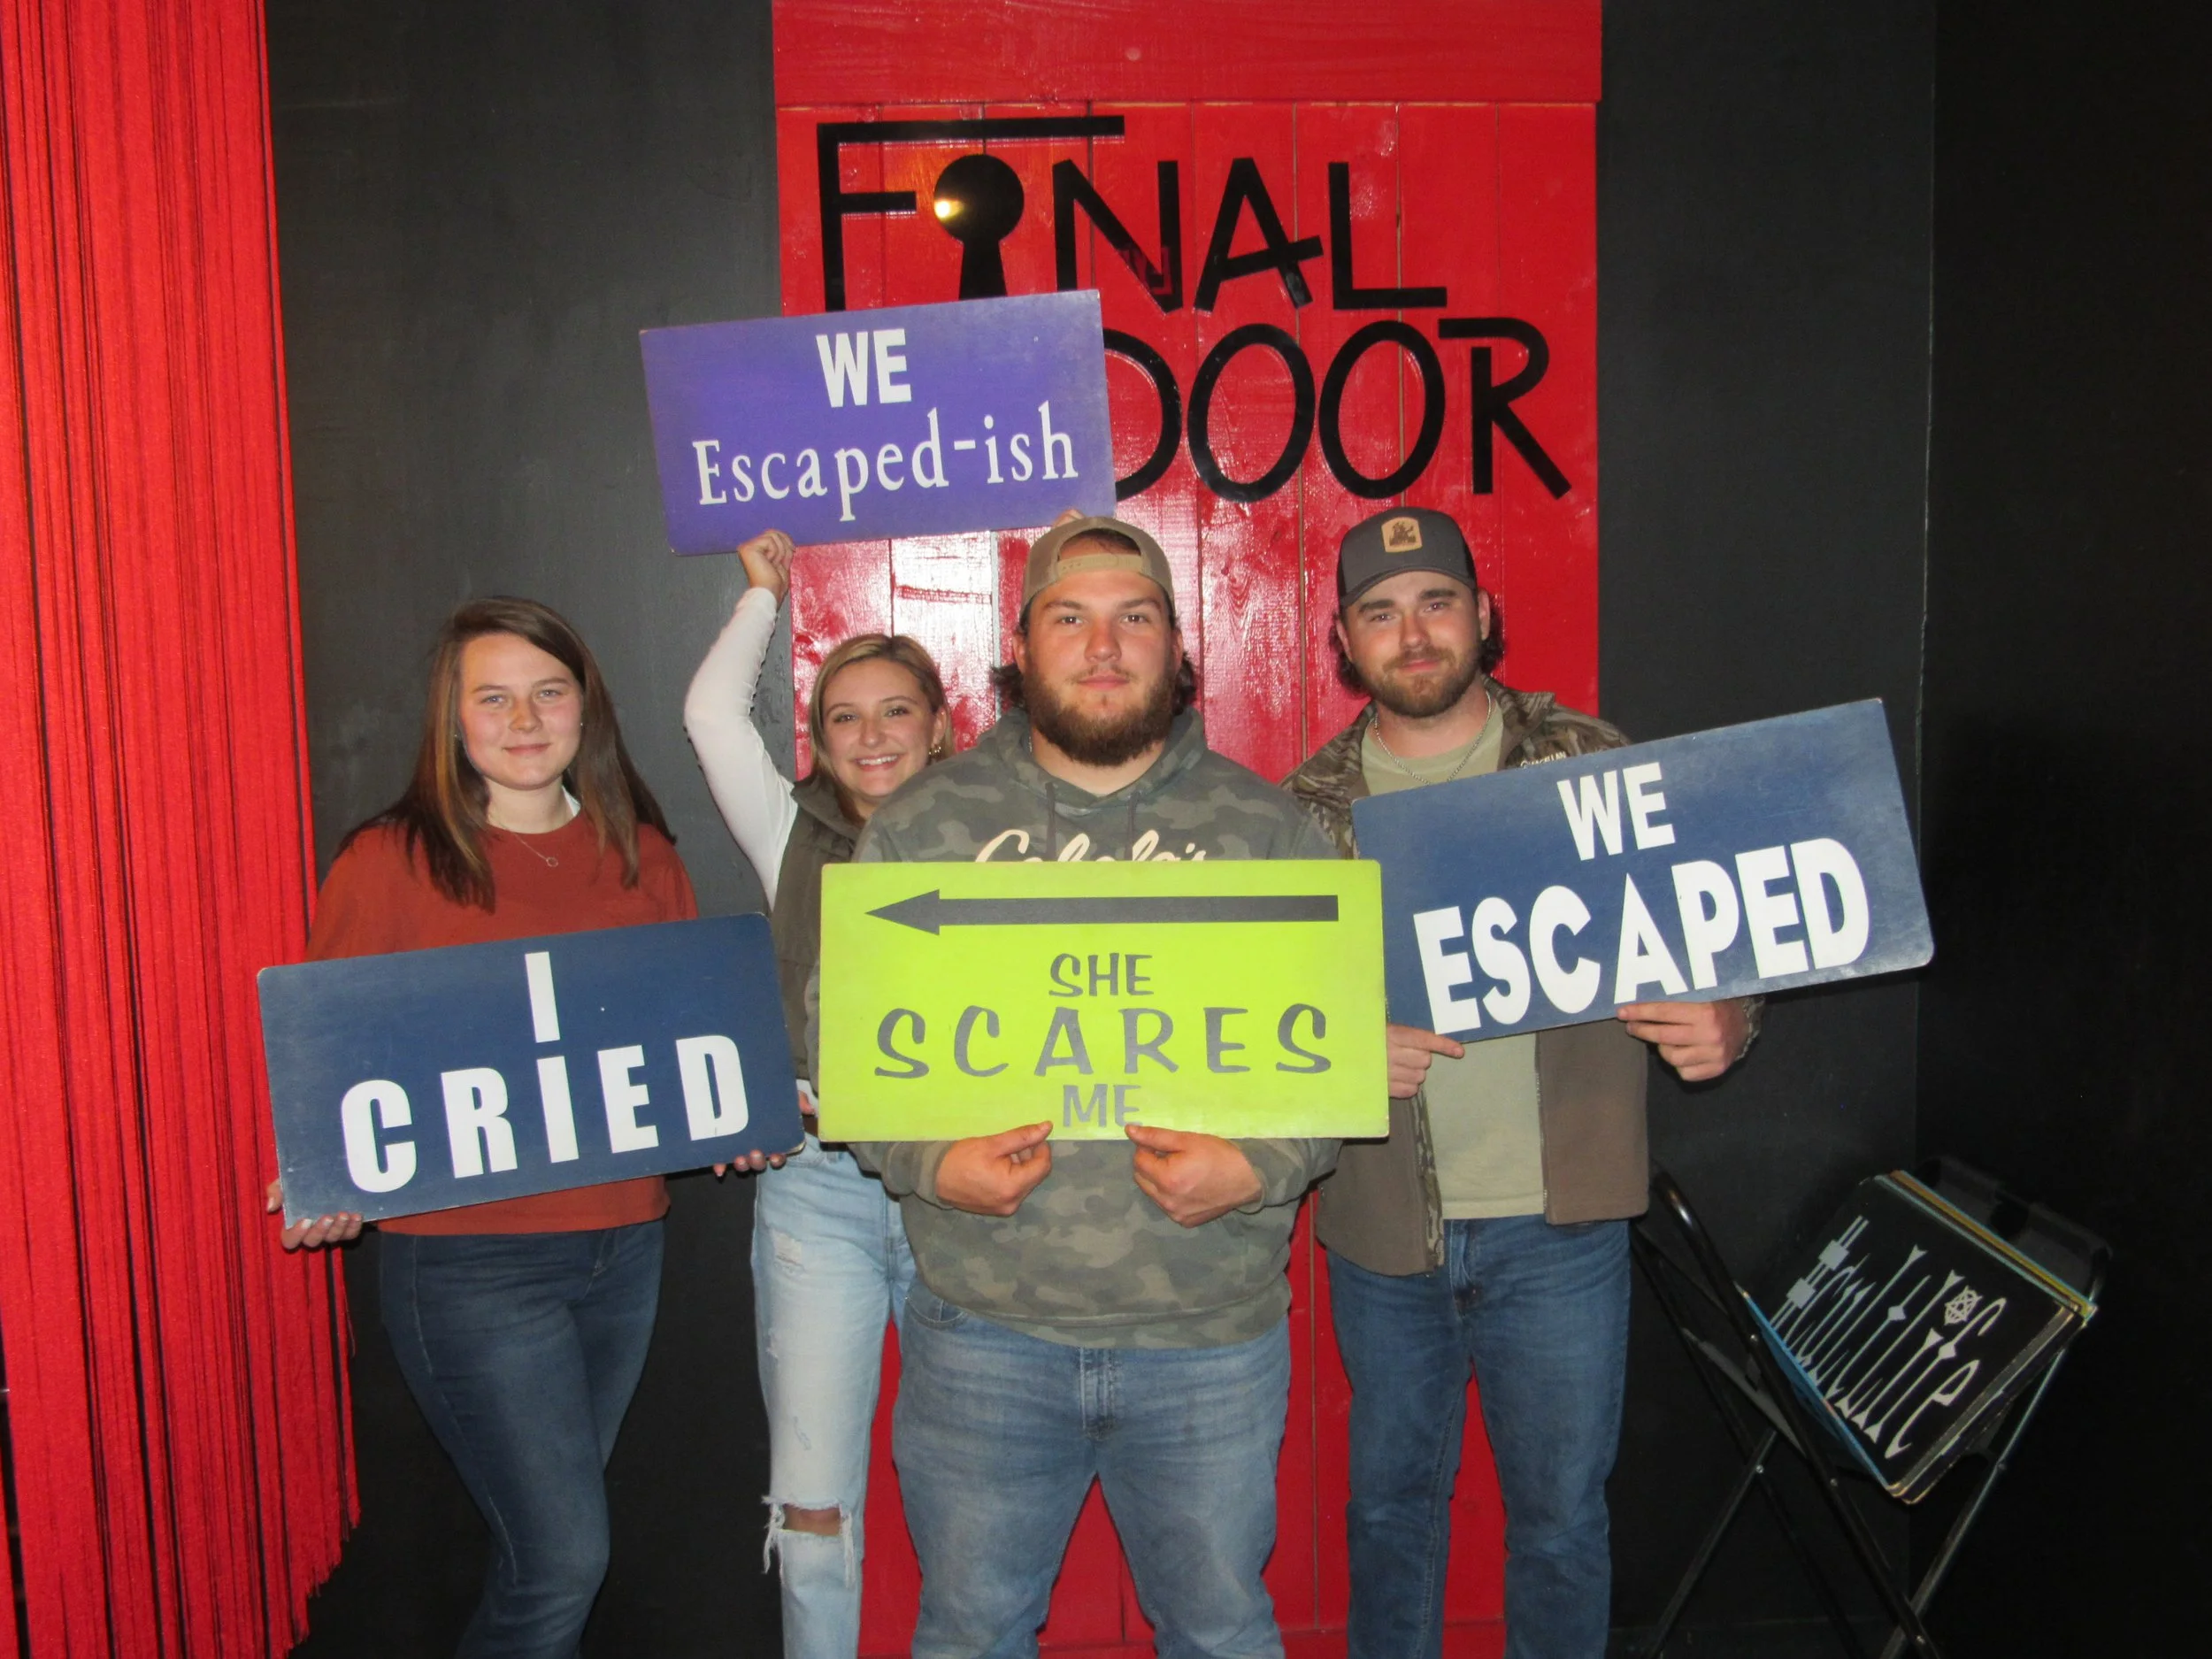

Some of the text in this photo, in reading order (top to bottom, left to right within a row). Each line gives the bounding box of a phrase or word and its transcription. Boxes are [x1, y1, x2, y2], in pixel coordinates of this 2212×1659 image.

[816, 328, 911, 407] WE
[693, 400, 1077, 523] Escaped-ish
[1556, 762, 1676, 861] WE
[1049, 953, 1154, 997] SHE
[1414, 838, 1869, 1035] ESCAPED
[525, 952, 560, 1042] I
[874, 1003, 1331, 1079] SCARES
[342, 1035, 749, 1193] CRIED
[1063, 1084, 1140, 1128] ME
